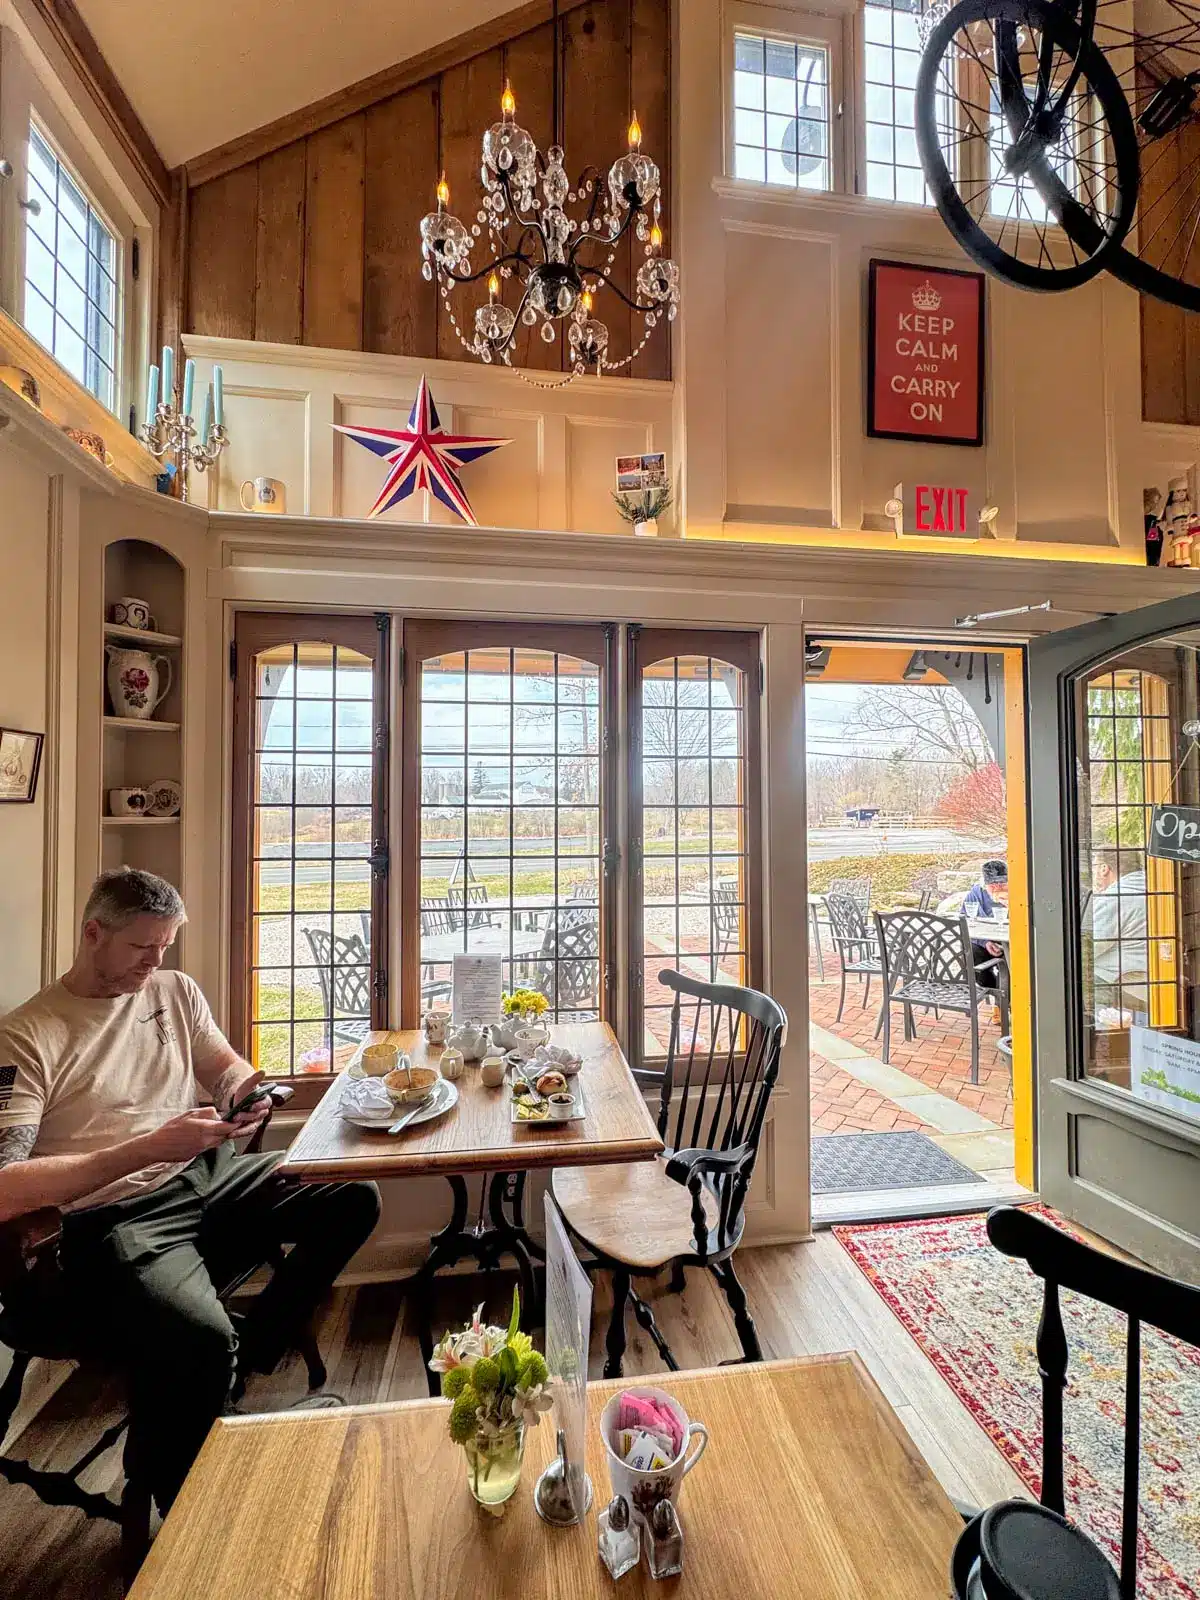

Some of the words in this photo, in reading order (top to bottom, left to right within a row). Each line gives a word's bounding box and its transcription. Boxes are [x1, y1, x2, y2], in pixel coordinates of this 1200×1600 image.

[898, 312, 955, 336] KEEP
[895, 338, 958, 361] CALM
[915, 363, 938, 373] AND
[890, 375, 961, 399] CARRY
[910, 402, 943, 422] ON
[915, 486, 969, 532] EXIT
[1161, 1043, 1183, 1053] SPRING
